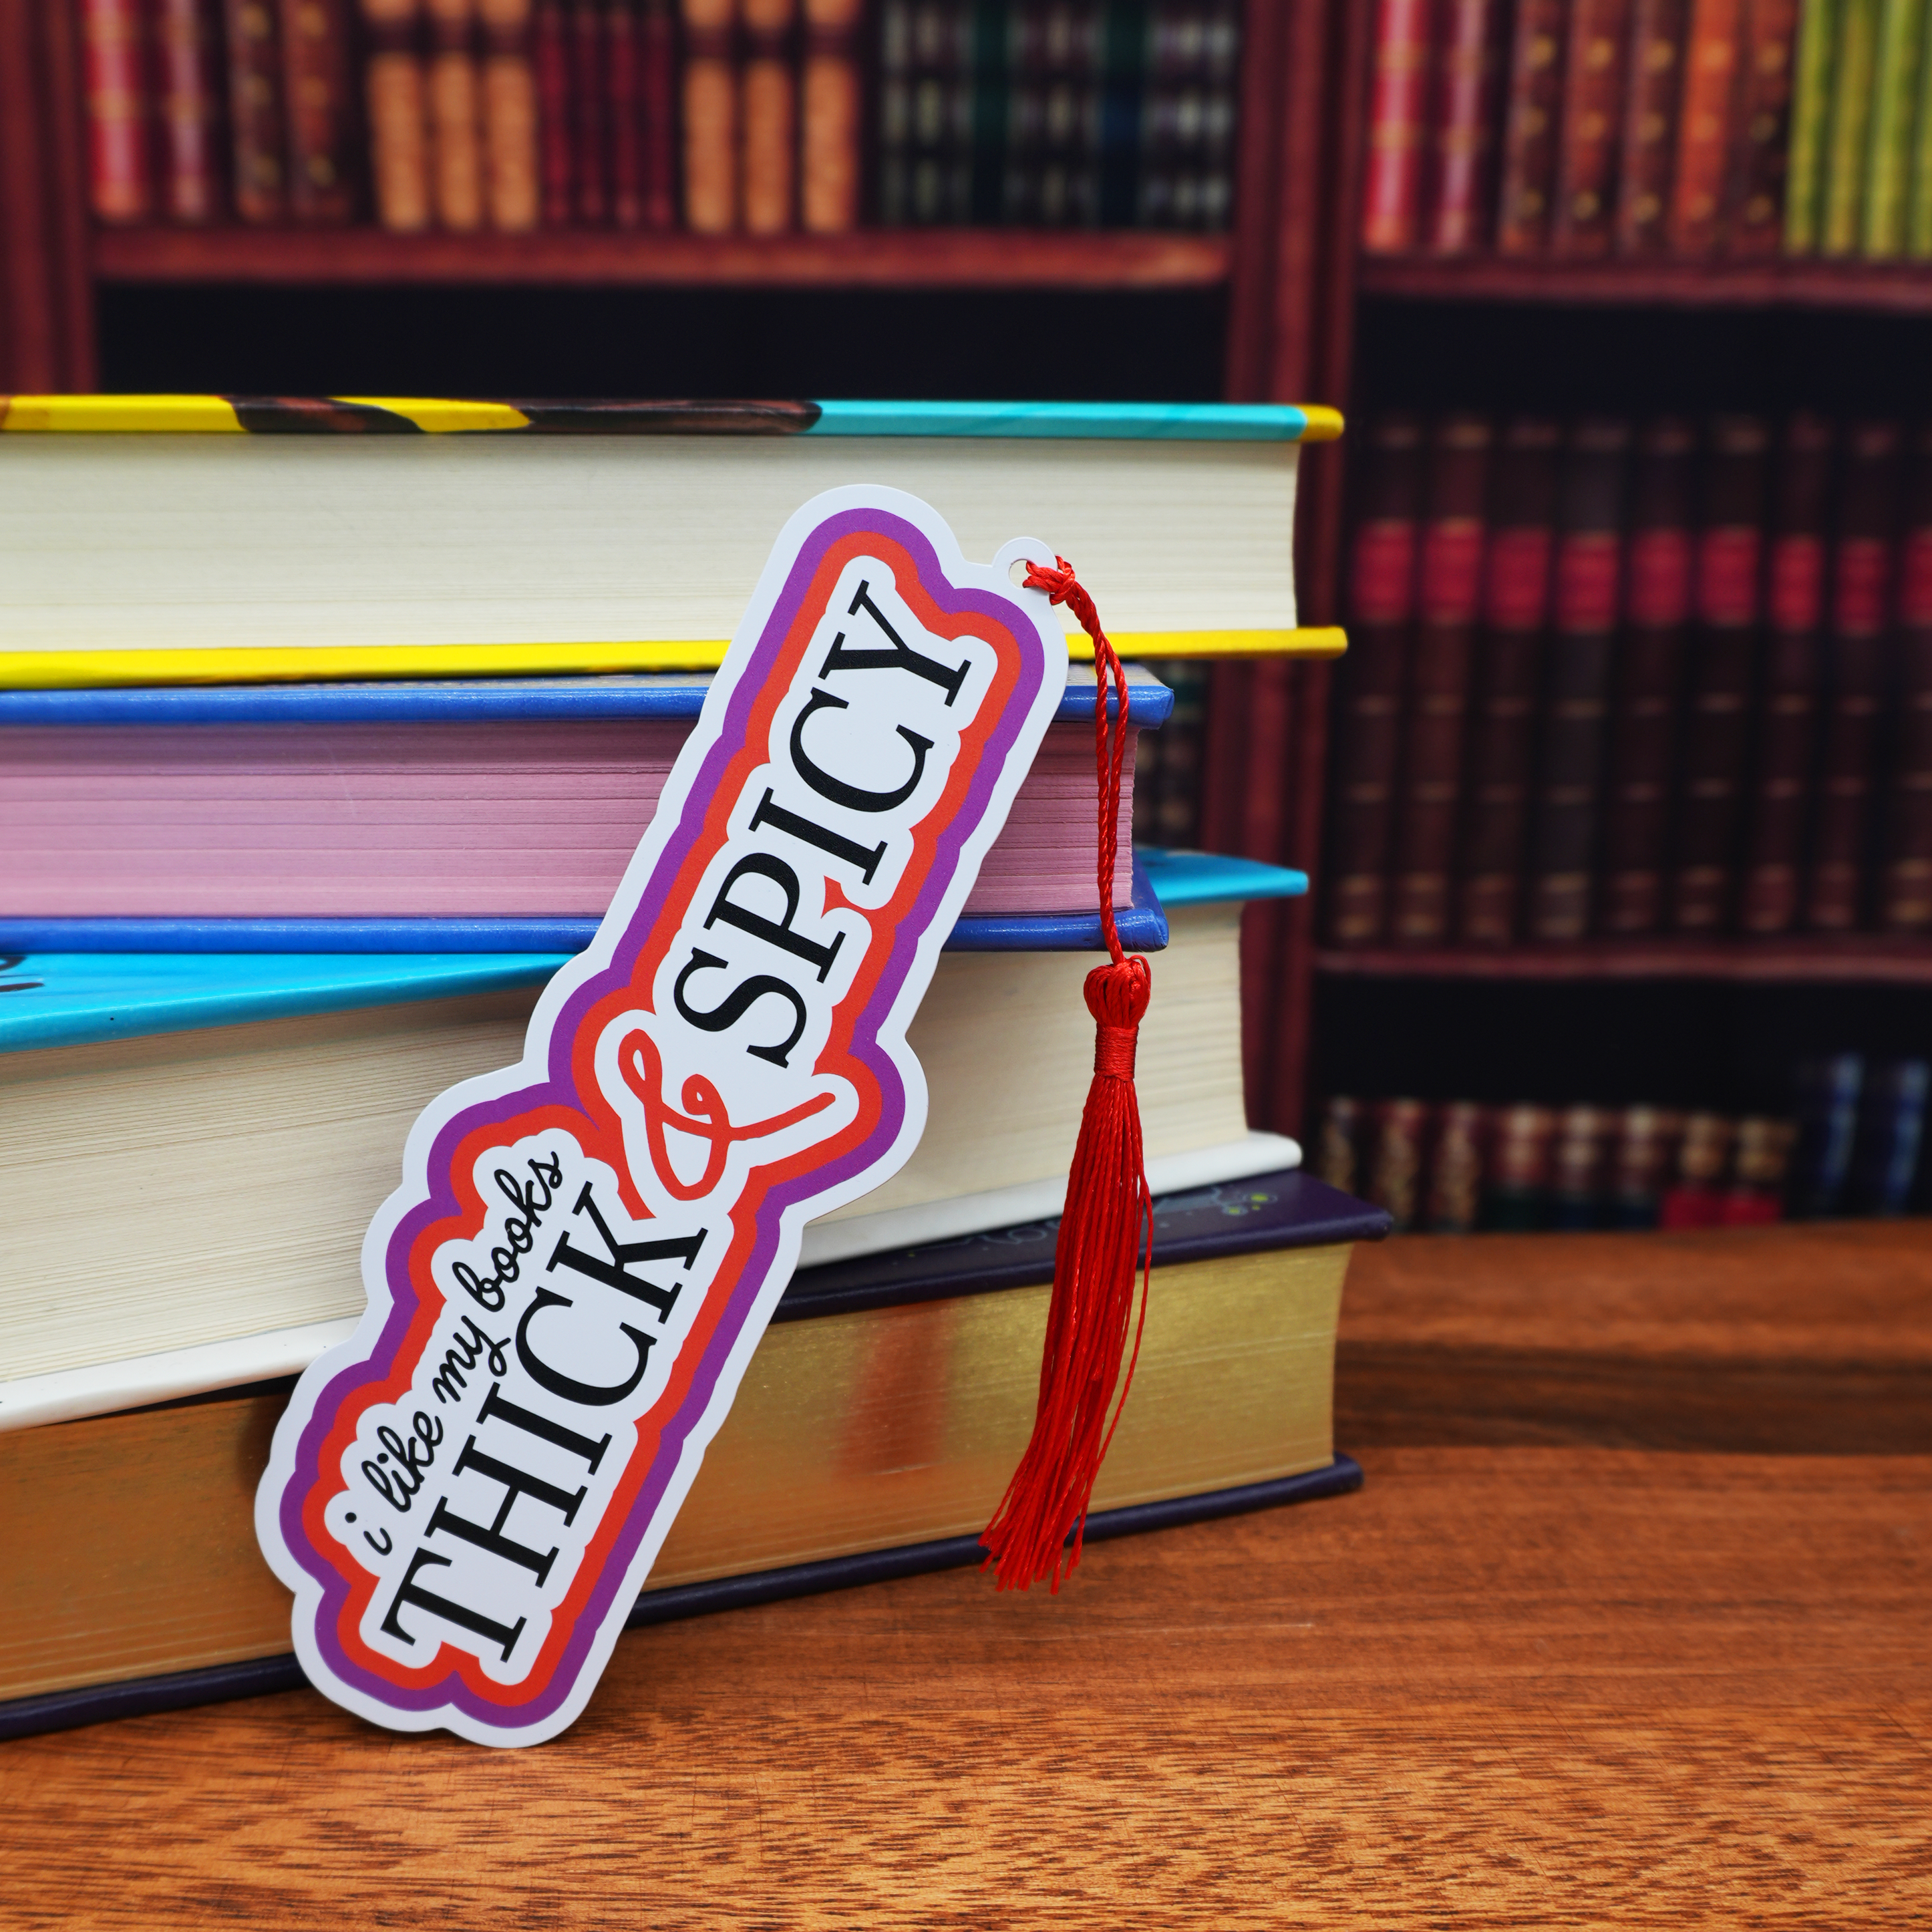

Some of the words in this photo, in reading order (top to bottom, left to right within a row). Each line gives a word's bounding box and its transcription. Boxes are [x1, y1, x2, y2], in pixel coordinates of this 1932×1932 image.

[673, 579, 971, 1069] SPICY
[618, 1028, 836, 1201] &
[452, 1151, 563, 1313] books
[381, 1180, 708, 1663] THICK
[432, 1315, 512, 1404] my
[345, 1512, 393, 1556] i
[361, 1411, 444, 1513] like
